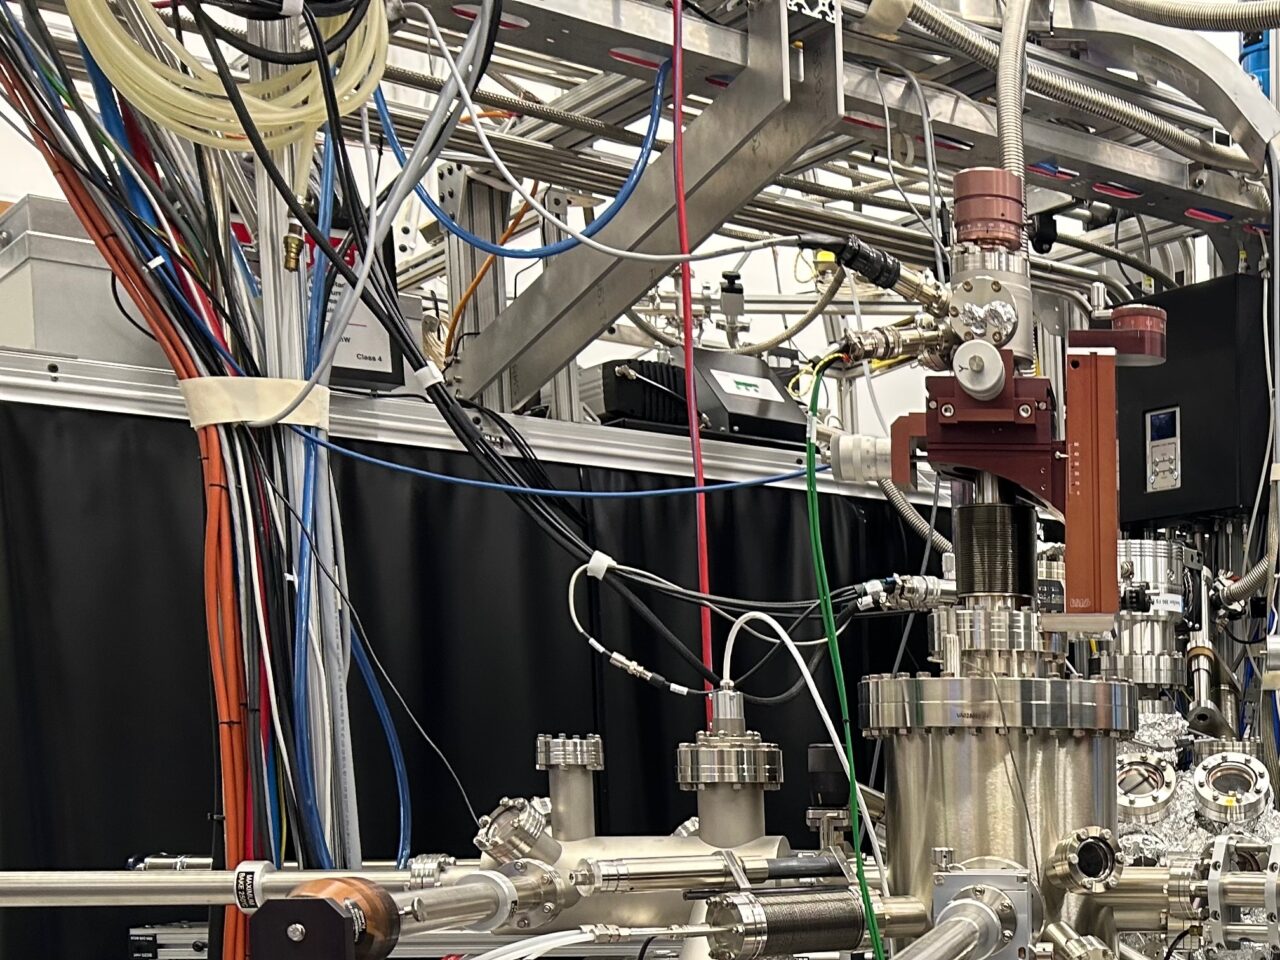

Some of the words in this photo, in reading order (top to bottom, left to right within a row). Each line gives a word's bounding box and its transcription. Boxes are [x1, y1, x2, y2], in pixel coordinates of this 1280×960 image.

[356, 353, 376, 362] Class
[958, 364, 969, 373] Y
[237, 872, 246, 890] BAKE
[246, 874, 255, 906] MAXIMUM
